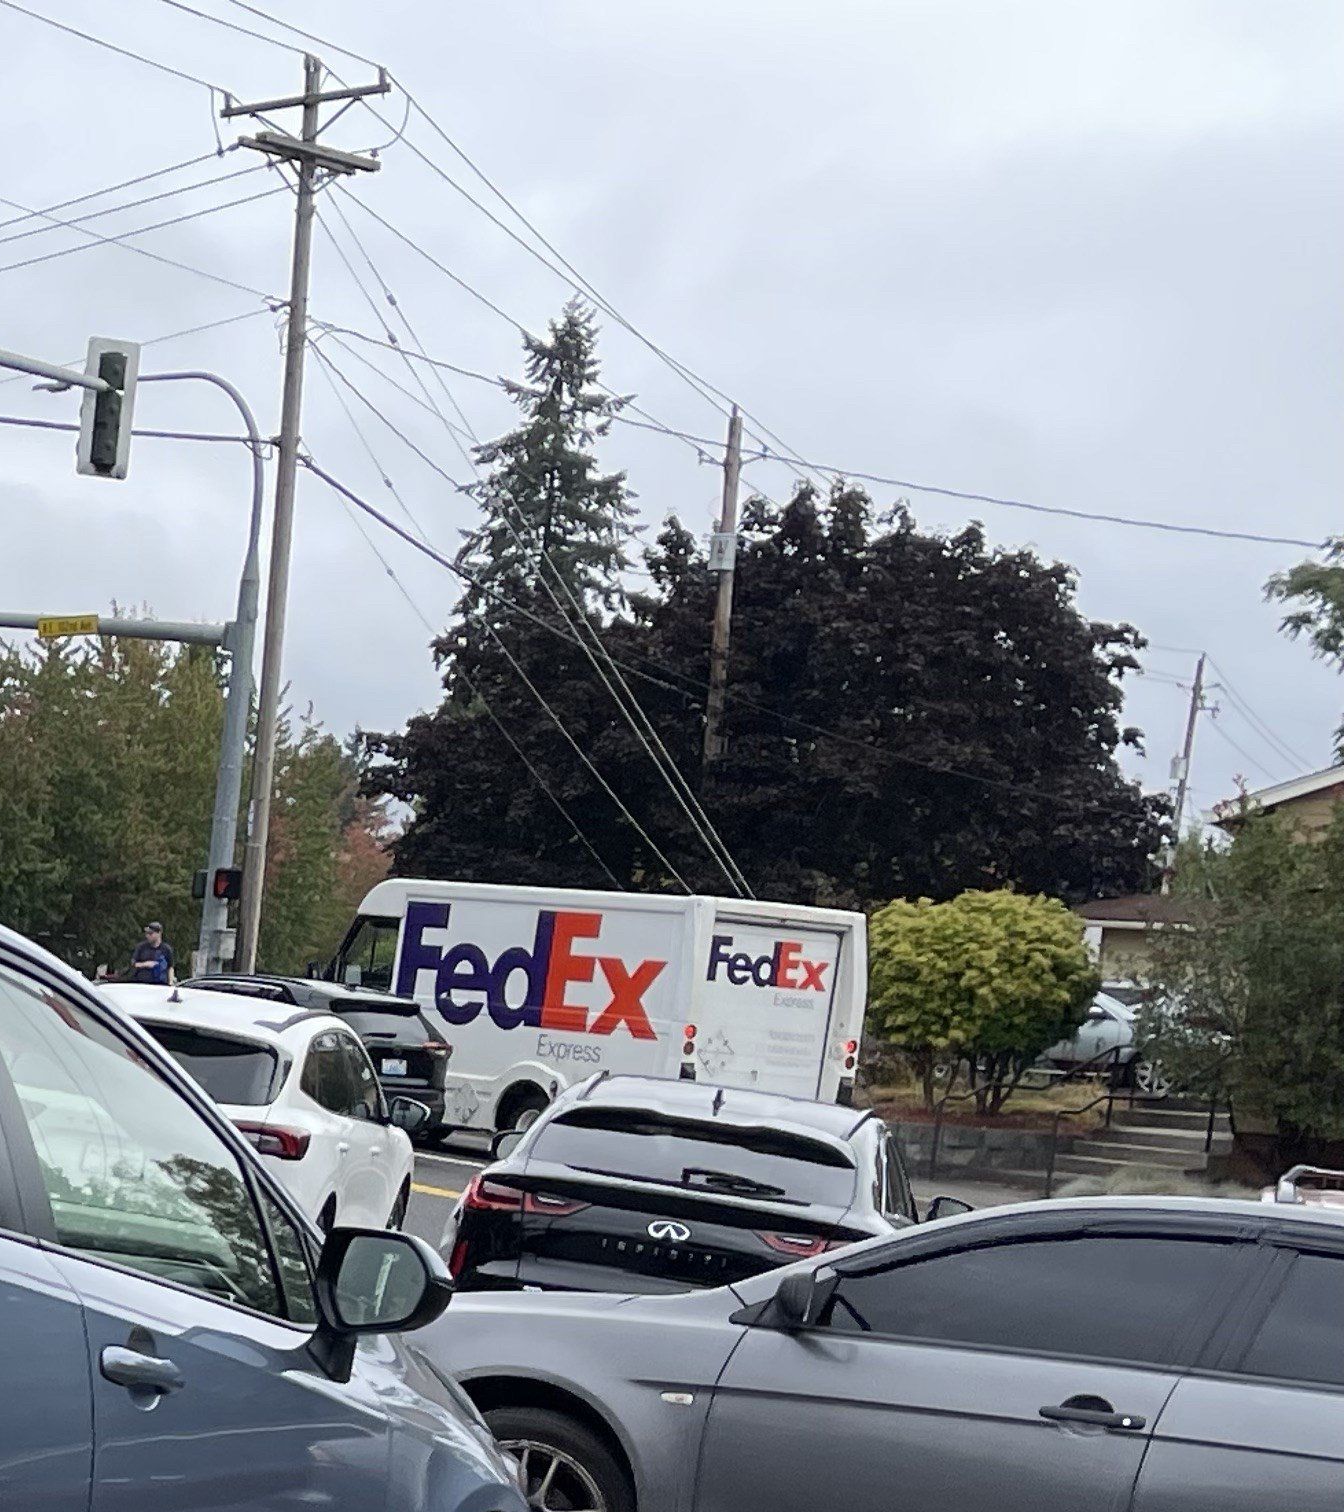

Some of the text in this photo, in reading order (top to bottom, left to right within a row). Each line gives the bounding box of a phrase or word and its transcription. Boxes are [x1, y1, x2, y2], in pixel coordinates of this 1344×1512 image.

[396, 900, 669, 1042] FedEx
[706, 934, 830, 992] FedEx
[535, 1033, 602, 1064] Express
